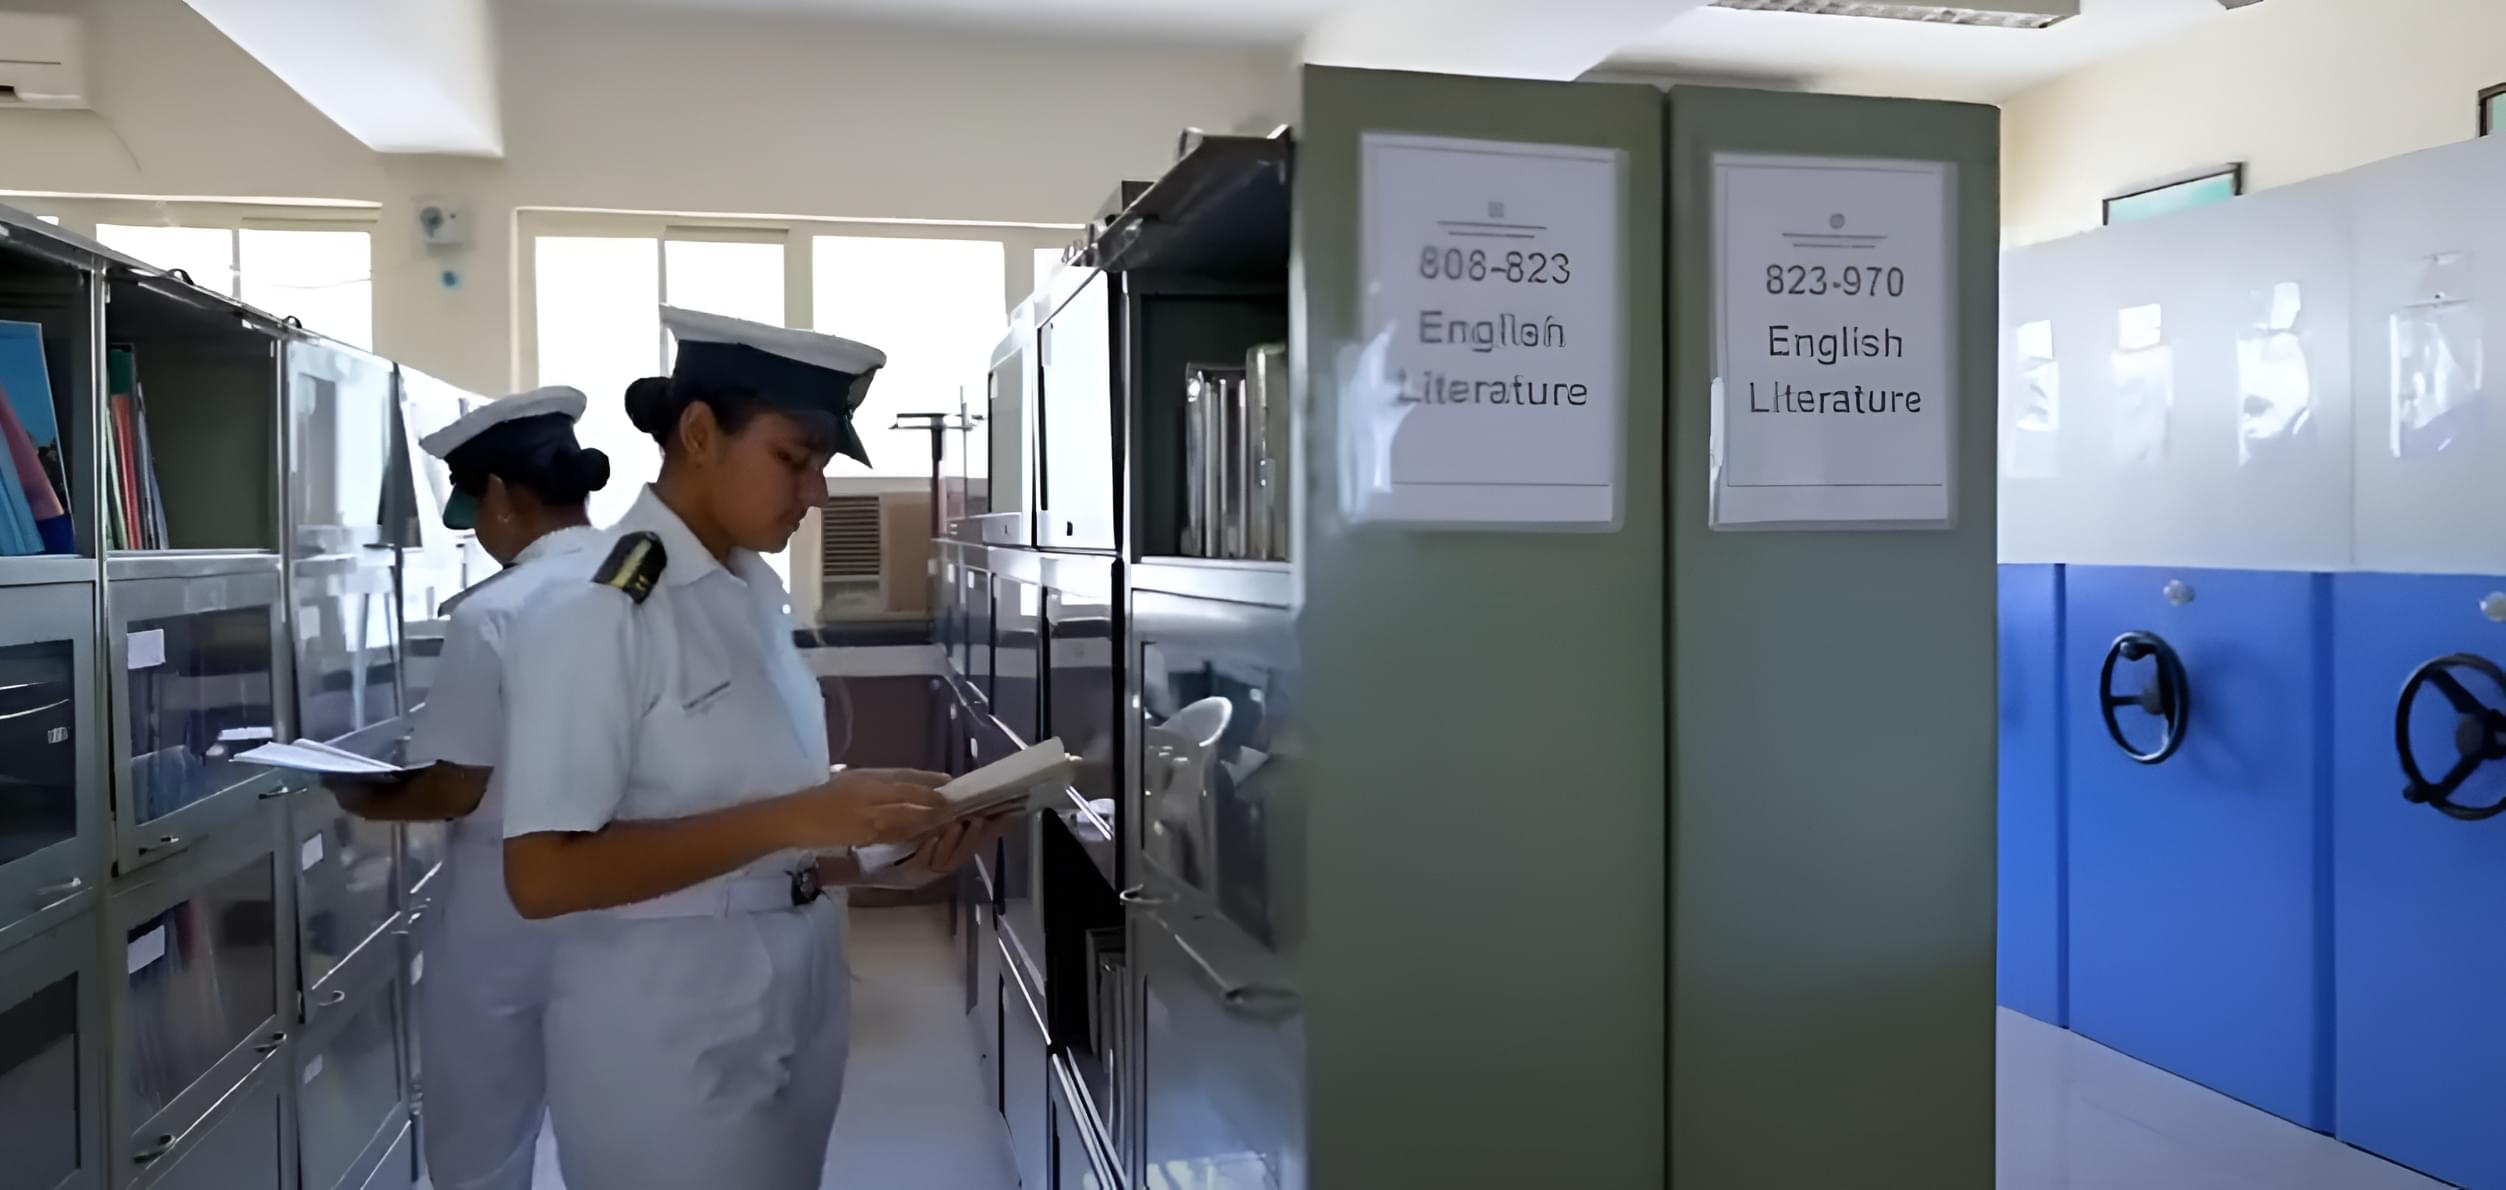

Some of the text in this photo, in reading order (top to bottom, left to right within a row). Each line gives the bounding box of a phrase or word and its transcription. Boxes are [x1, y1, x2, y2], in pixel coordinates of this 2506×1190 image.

[1419, 245, 1571, 284] 808-823
[1765, 263, 1905, 297] 823-970
[1768, 324, 1903, 365] English
[1749, 380, 1922, 414] Literature
